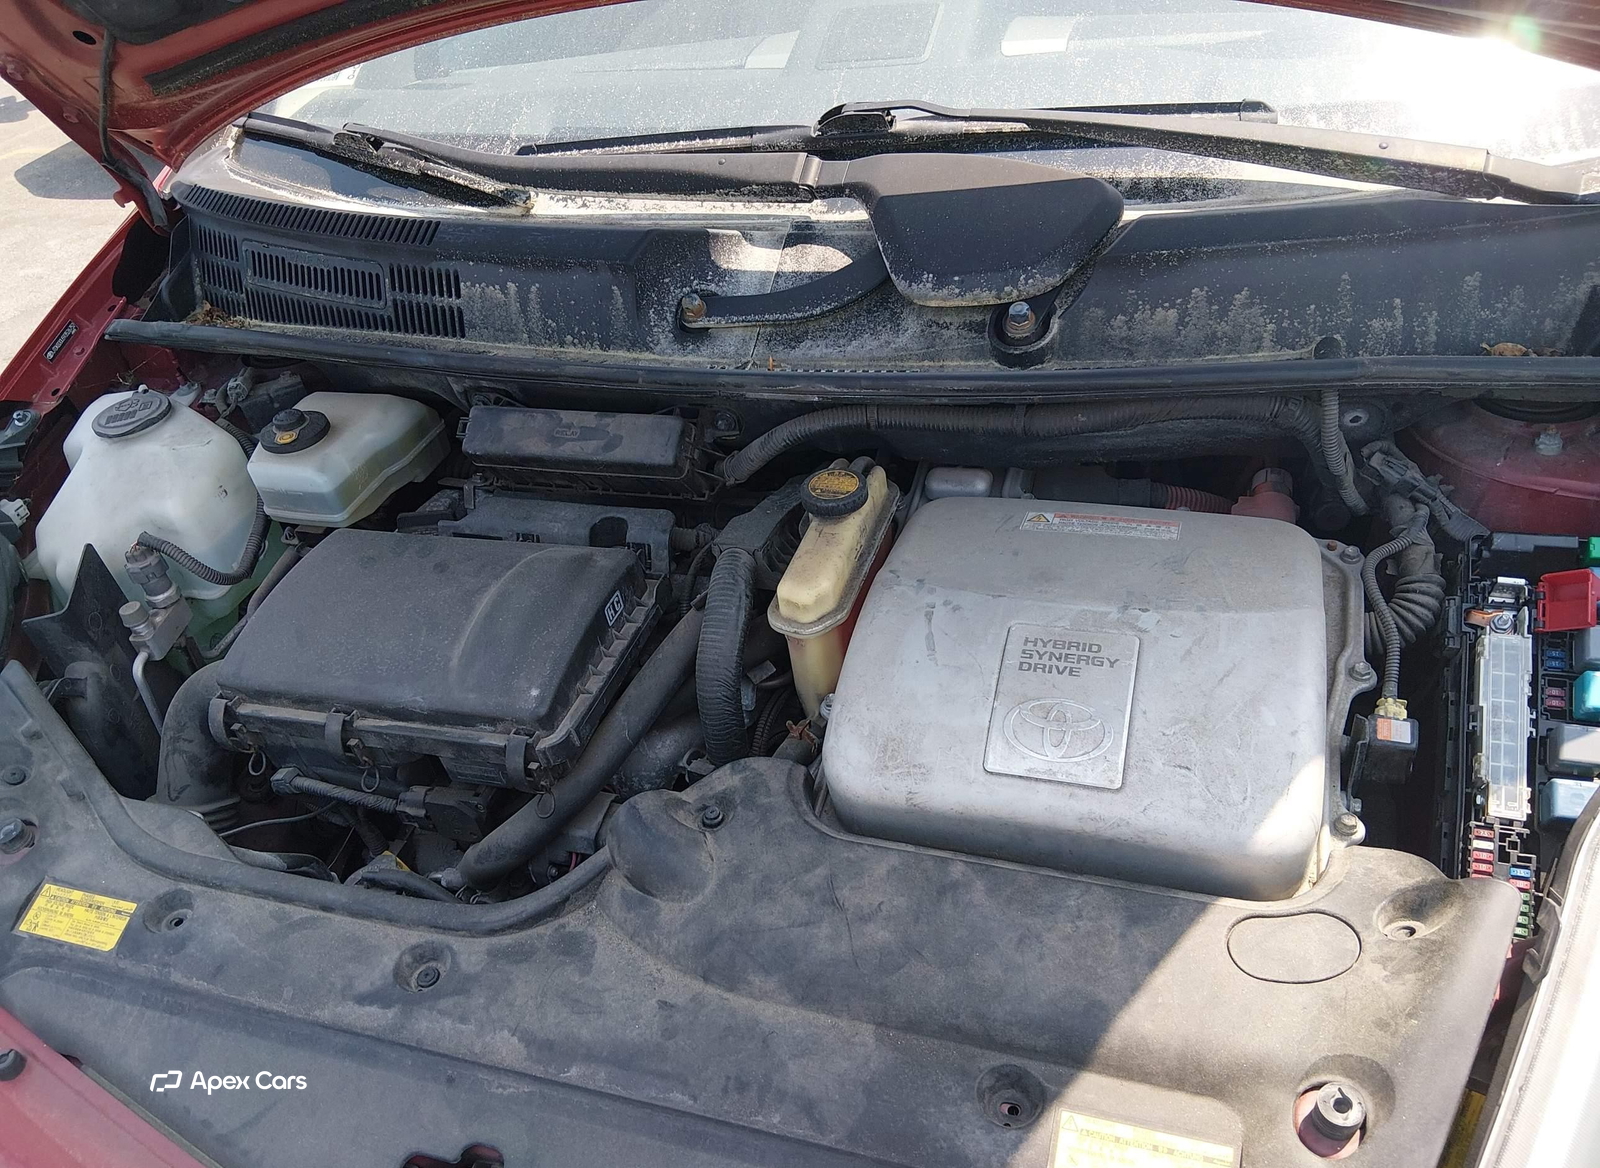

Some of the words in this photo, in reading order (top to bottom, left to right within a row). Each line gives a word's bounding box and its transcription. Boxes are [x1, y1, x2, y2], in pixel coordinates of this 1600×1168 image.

[1023, 636, 1103, 654] HYBRID
[1020, 649, 1120, 668] SYNERGY
[1018, 661, 1082, 677] DRIVE
